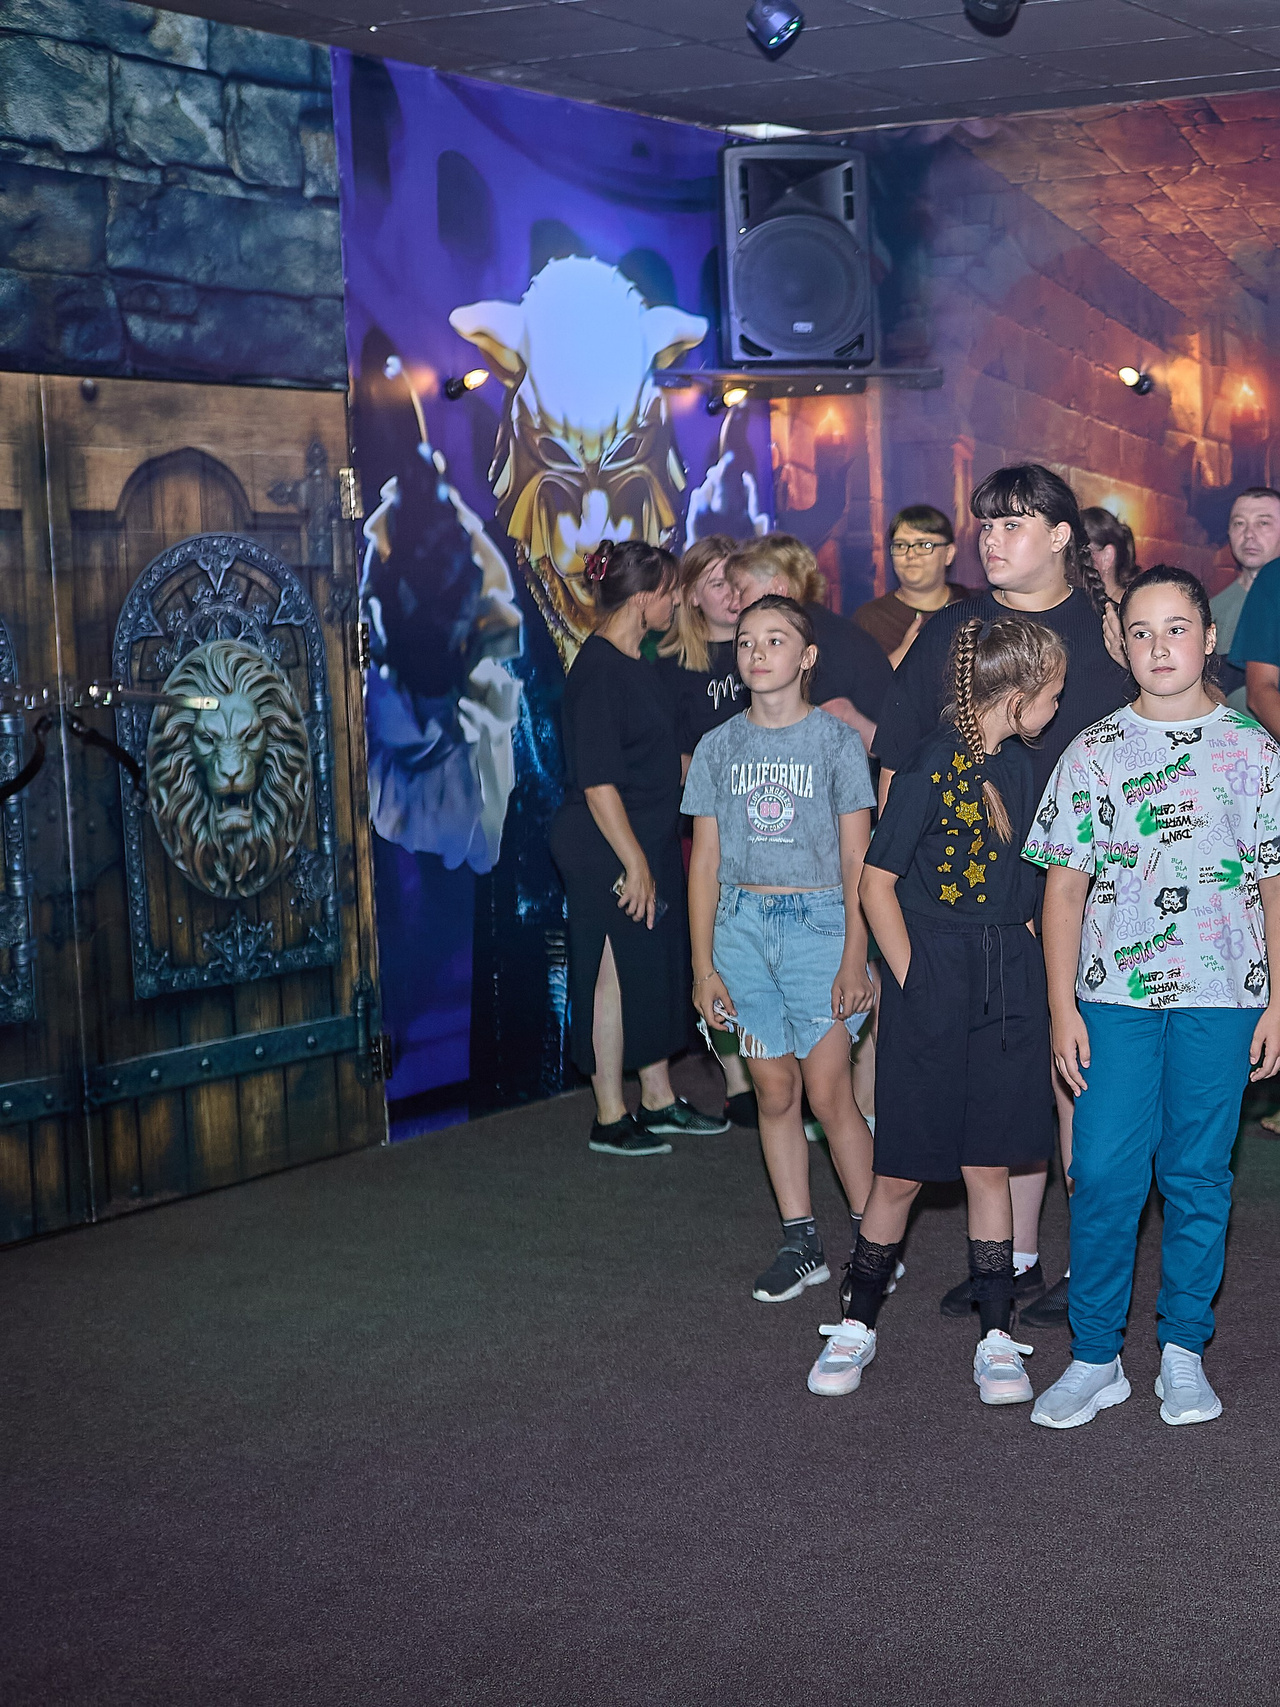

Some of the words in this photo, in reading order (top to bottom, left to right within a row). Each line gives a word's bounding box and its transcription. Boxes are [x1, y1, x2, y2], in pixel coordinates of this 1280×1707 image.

[731, 763, 814, 798] CALIFORNIA
[750, 791, 761, 806] LOS
[764, 786, 792, 808] ANGELES
[759, 801, 780, 818] 89
